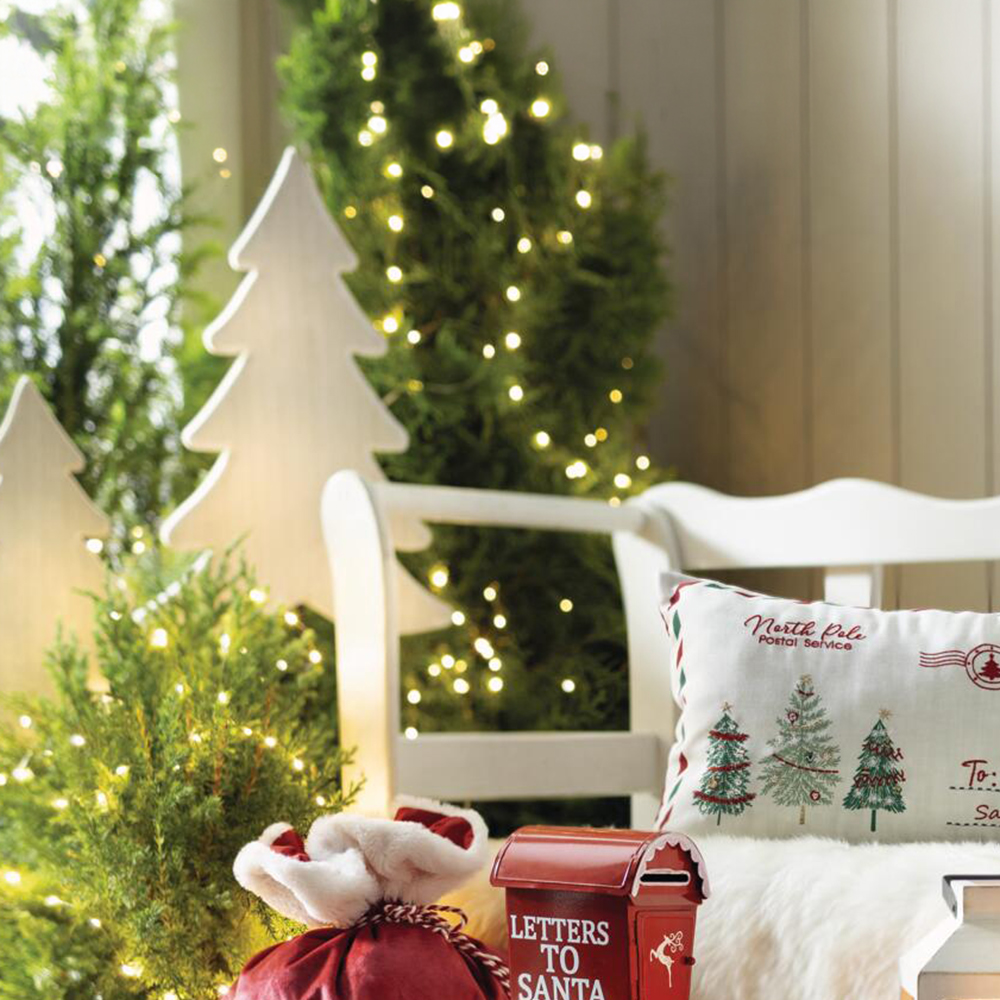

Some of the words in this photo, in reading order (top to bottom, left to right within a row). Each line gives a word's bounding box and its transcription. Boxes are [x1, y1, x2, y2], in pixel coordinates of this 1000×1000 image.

[744, 614, 815, 635] North
[821, 623, 867, 641] Pole
[758, 634, 798, 647] Postal
[804, 638, 853, 650] Service
[961, 760, 996, 787] To:
[510, 914, 609, 946] LETTERS
[540, 943, 579, 975] TO
